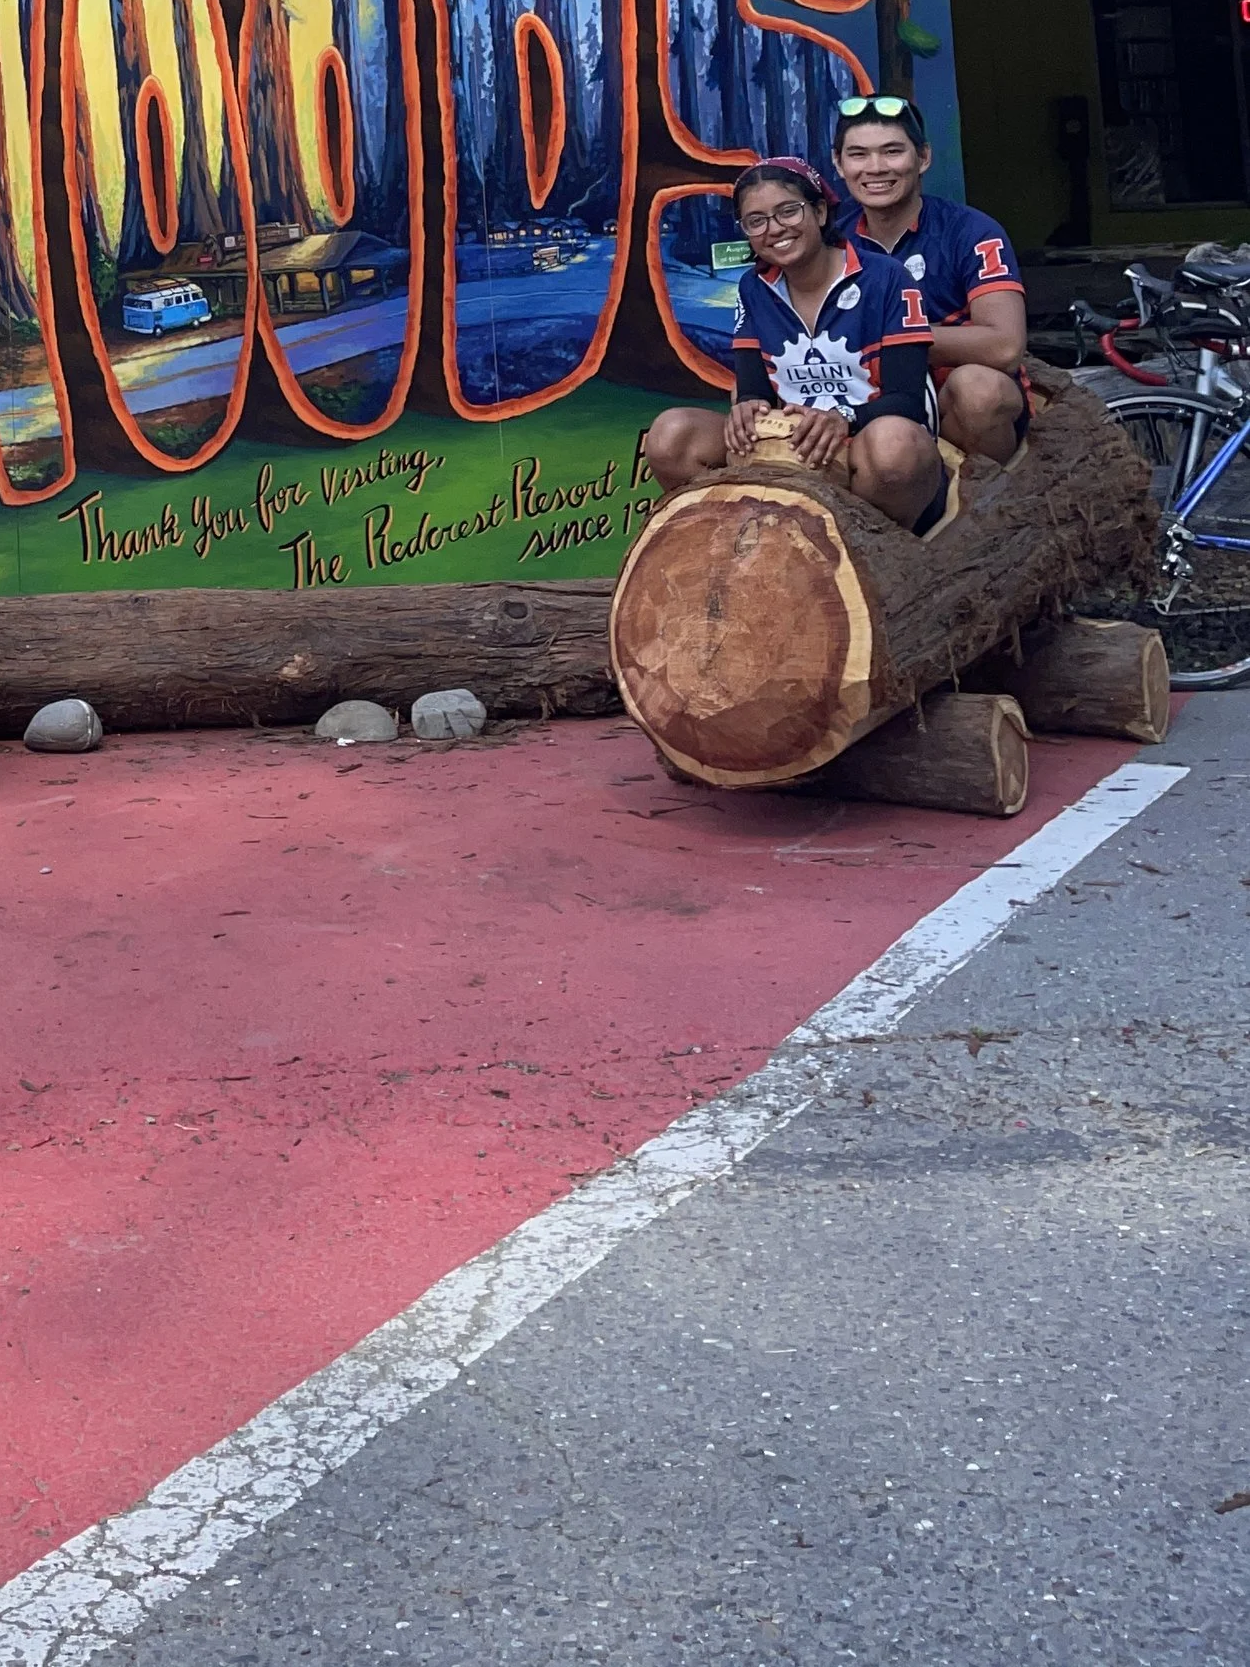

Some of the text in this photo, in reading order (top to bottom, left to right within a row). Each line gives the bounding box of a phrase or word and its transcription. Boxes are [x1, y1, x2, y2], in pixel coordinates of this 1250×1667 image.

[974, 238, 1009, 280] I
[901, 288, 929, 328] I
[786, 364, 853, 382] ILLINI
[800, 381, 848, 396] 4000
[57, 448, 447, 565] Thank You for Visiting,
[278, 529, 352, 590] The
[362, 492, 508, 570] Redcrest
[511, 456, 622, 522] Resort
[517, 497, 654, 563] since 19
